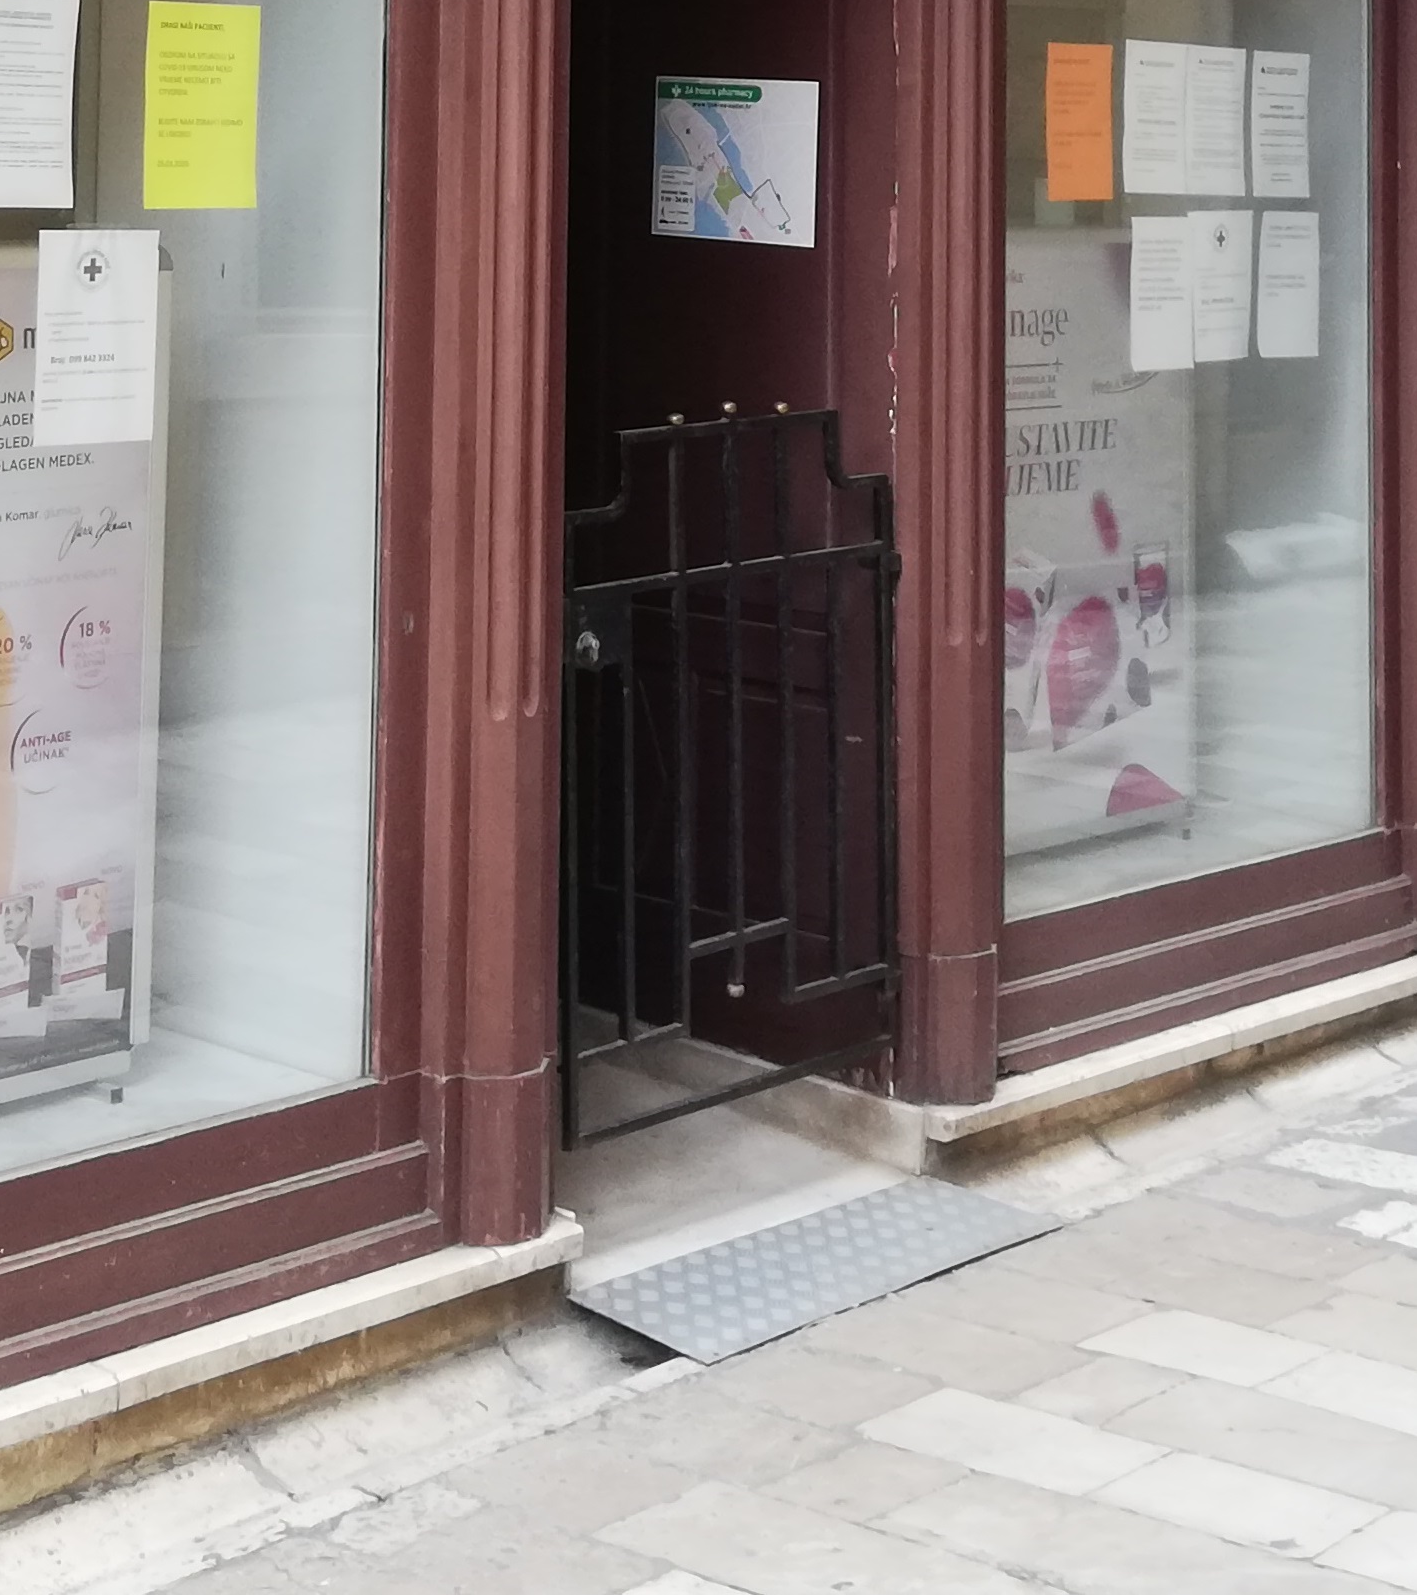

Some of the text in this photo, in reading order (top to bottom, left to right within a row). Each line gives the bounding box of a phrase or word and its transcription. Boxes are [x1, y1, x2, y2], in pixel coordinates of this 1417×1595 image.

[49, 452, 95, 469] MEDEX.
[79, 620, 112, 638] 18 %
[19, 634, 32, 651] %
[20, 731, 72, 749] ANTI-AGE
